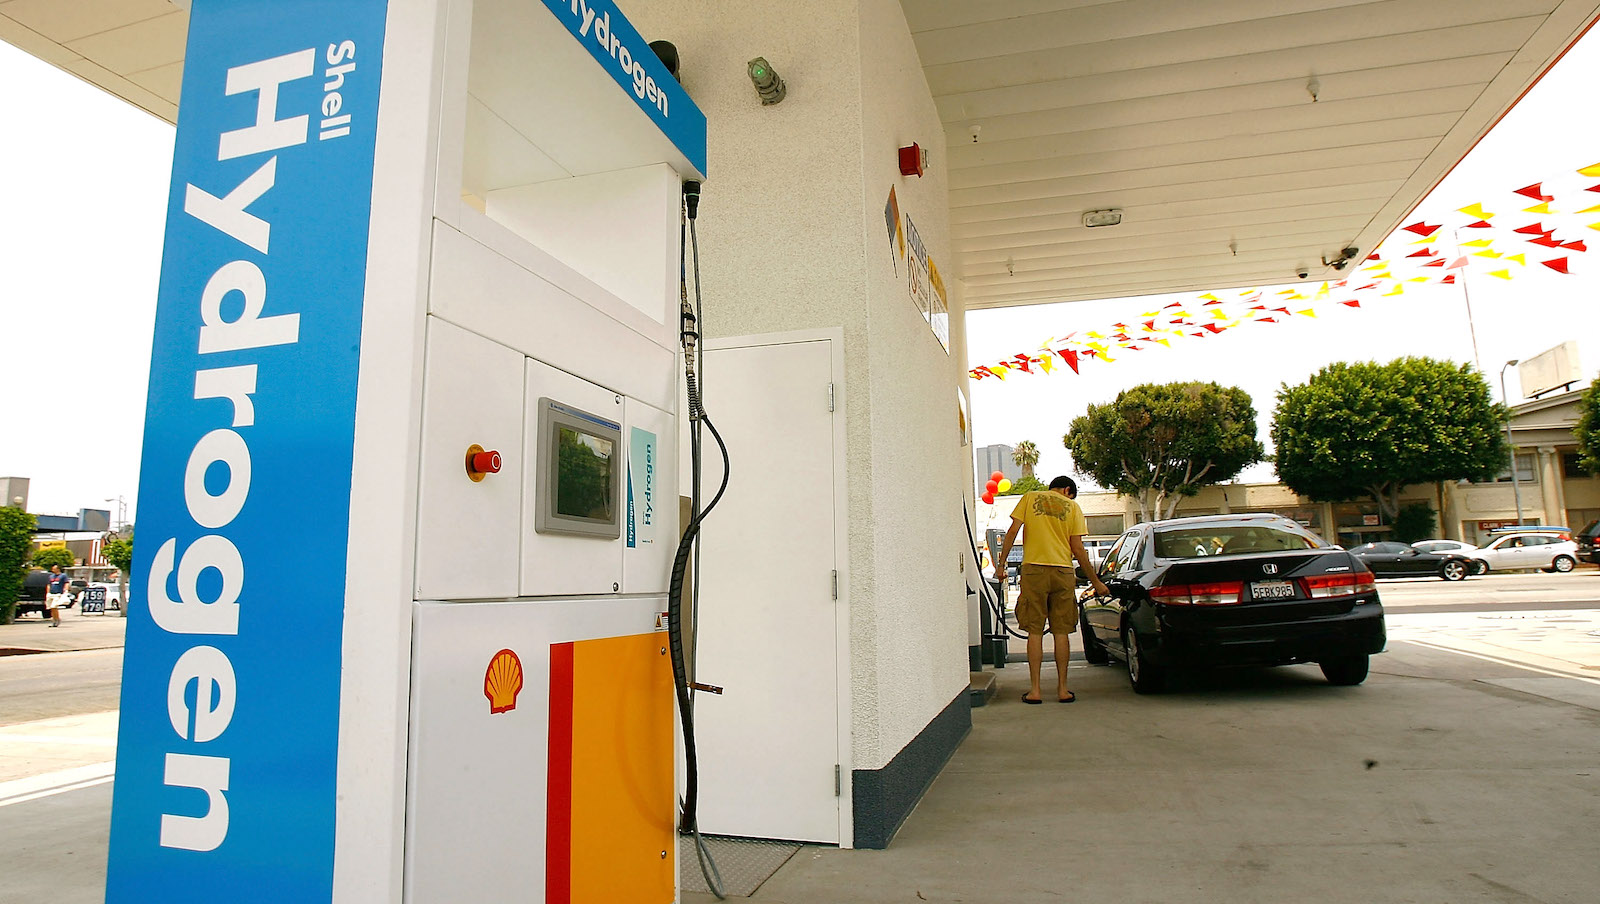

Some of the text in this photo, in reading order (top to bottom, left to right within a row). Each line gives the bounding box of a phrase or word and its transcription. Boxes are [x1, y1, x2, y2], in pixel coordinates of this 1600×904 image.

[319, 39, 356, 141] Shell
[562, 0, 669, 118] ydrogen
[148, 47, 316, 852] Hydrogen
[644, 443, 653, 525] Hydrogen
[1253, 585, 1293, 598] 5EBK985
